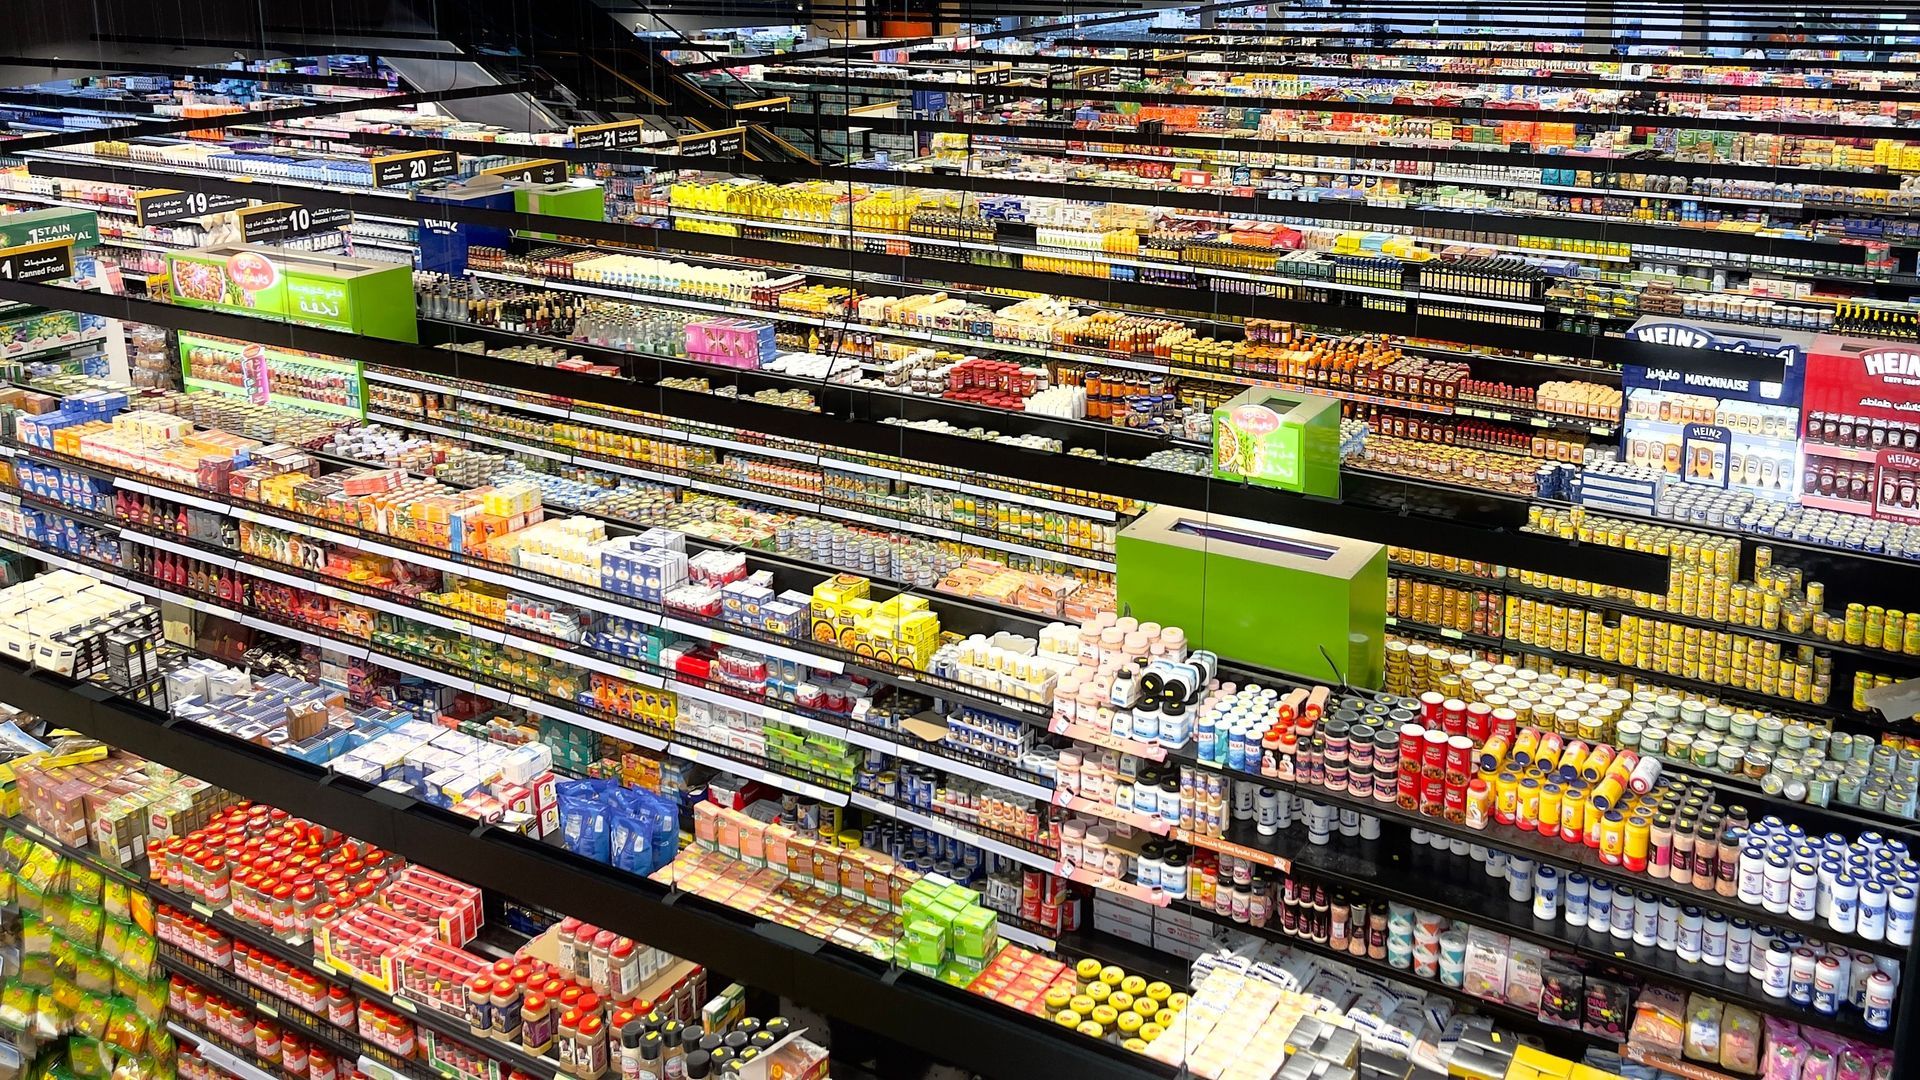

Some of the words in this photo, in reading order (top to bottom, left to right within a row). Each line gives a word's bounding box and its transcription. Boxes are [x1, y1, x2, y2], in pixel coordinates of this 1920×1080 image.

[604, 130, 616, 147] 21
[710, 140, 716, 156] 8
[410, 160, 426, 178] 20
[186, 193, 206, 214] 19
[289, 208, 310, 231] 10
[38, 224, 70, 236] STAIN
[2, 260, 12, 279] 1
[24, 256, 57, 267] معلبات
[19, 268, 45, 278] Canned
[46, 264, 65, 273] Food
[1864, 352, 1920, 378] HEIN
[1646, 367, 1680, 381] مايونيز
[1684, 374, 1749, 392] MAYONNAISE
[1692, 427, 1723, 439] HEINZ
[1887, 454, 1920, 467] HEINZ
